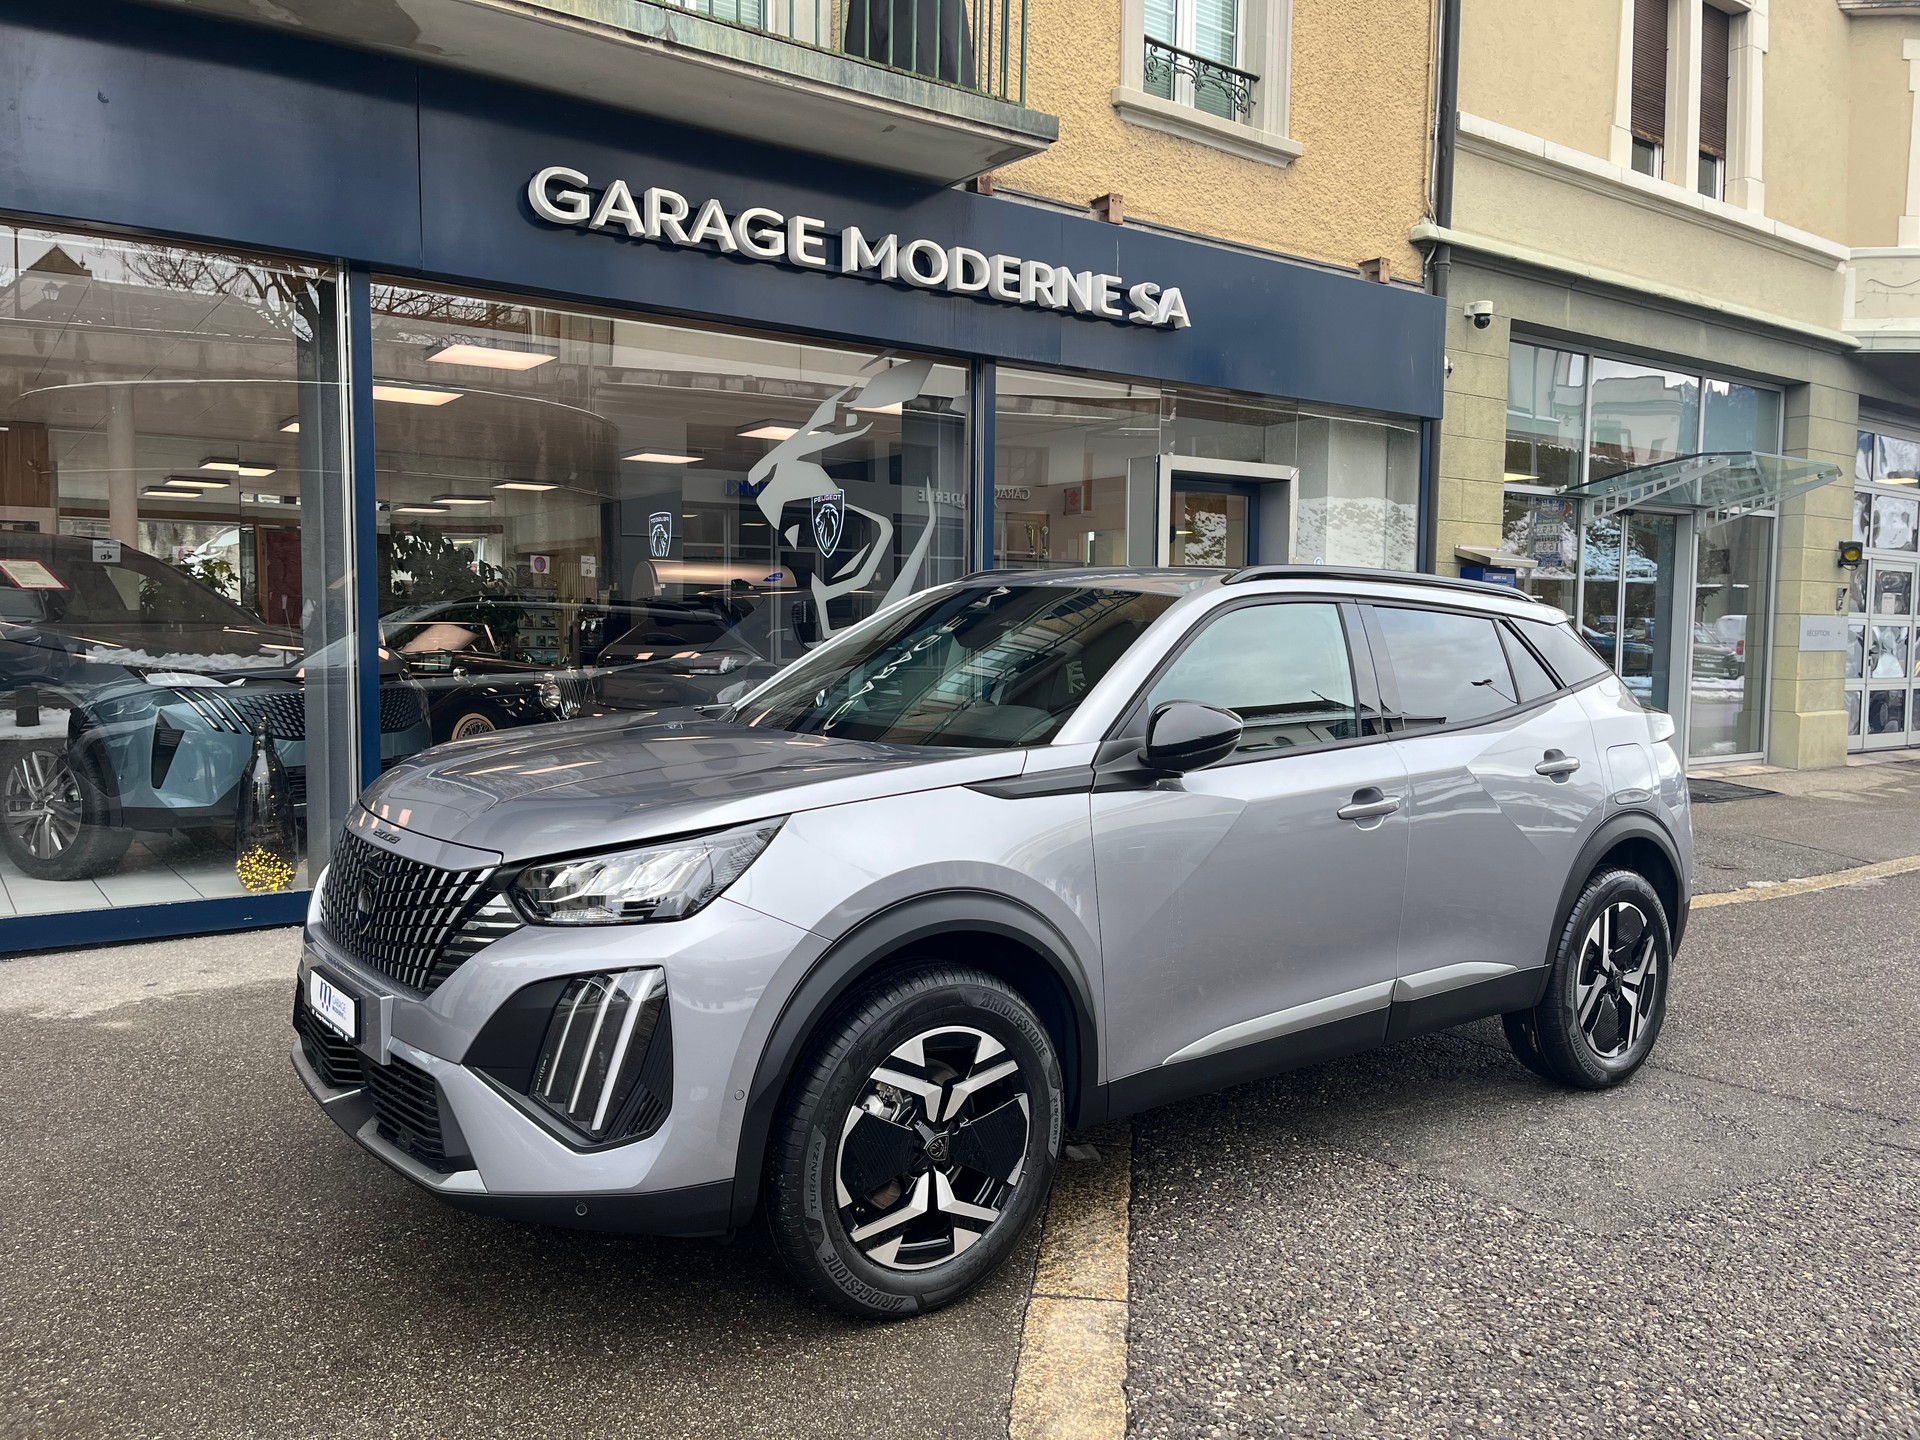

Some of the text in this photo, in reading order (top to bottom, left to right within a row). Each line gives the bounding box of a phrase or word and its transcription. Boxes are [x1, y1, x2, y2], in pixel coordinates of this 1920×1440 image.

[527, 165, 1192, 330] GARAGE MODERNE SA
[813, 493, 842, 504] PEUGEOT
[373, 829, 402, 844] 2008
[979, 992, 1048, 1058] BRIDGESTONE
[1571, 1032, 1602, 1079] BRIDGESTONE
[810, 1141, 822, 1212] TURANZA
[823, 1252, 907, 1311] BRIDGESTONE
